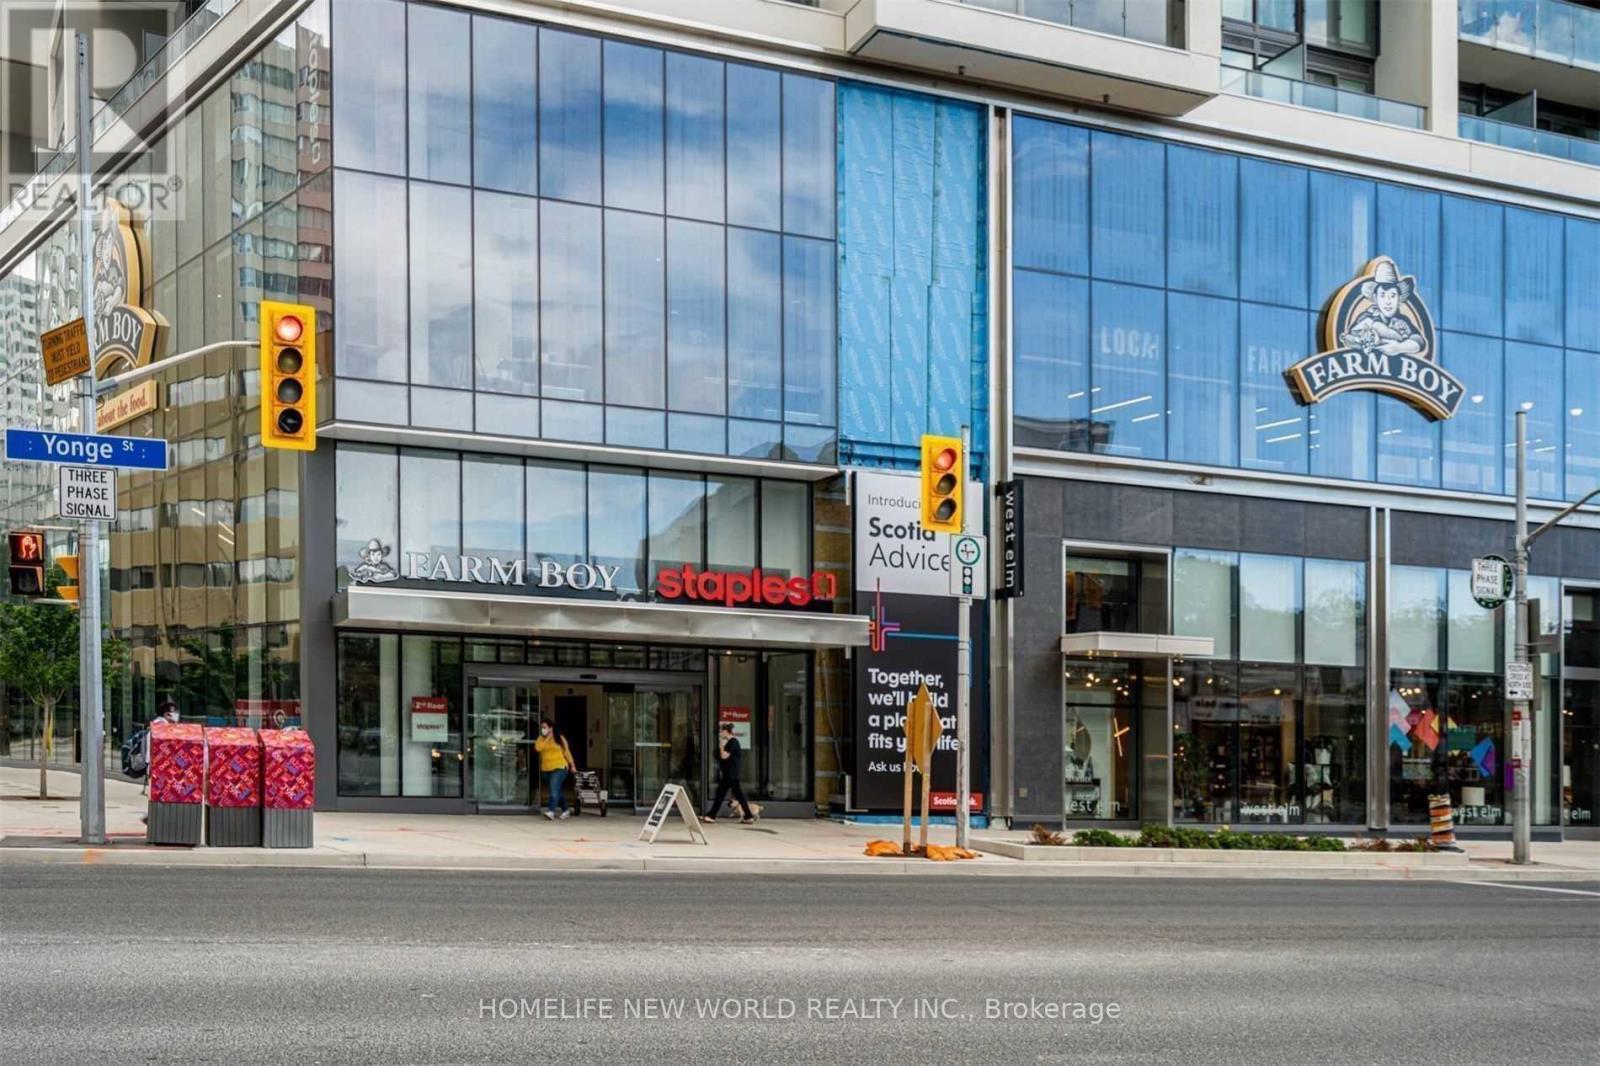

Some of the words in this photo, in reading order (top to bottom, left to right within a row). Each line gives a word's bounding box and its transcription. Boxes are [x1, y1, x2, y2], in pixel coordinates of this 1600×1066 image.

[112, 311, 142, 350] BOY
[65, 341, 80, 357] YIELD
[1307, 352, 1392, 390] FARM
[1398, 357, 1459, 404] BOY
[117, 398, 129, 416] the
[42, 434, 113, 463] Yonge
[122, 439, 134, 452] St
[68, 469, 107, 484] THREE
[67, 486, 109, 500] PHASE
[868, 494, 921, 509] Introduci
[66, 502, 110, 518] SIGNAL
[1005, 491, 1016, 543] west
[869, 517, 936, 542] Scotia
[869, 542, 950, 572] Advice
[405, 551, 526, 586] FARM
[538, 560, 621, 592] BOY
[1005, 549, 1016, 588] elm
[657, 562, 811, 608] staples
[1476, 574, 1498, 585] PHASE
[868, 668, 944, 689] Together,
[868, 690, 904, 707] we'll
[908, 691, 948, 708] bild
[868, 713, 880, 727] a
[868, 733, 893, 749] fits
[868, 761, 887, 772] Ask
[889, 764, 901, 773] us
[1481, 804, 1502, 818] elm
[1571, 807, 1591, 820] elm
